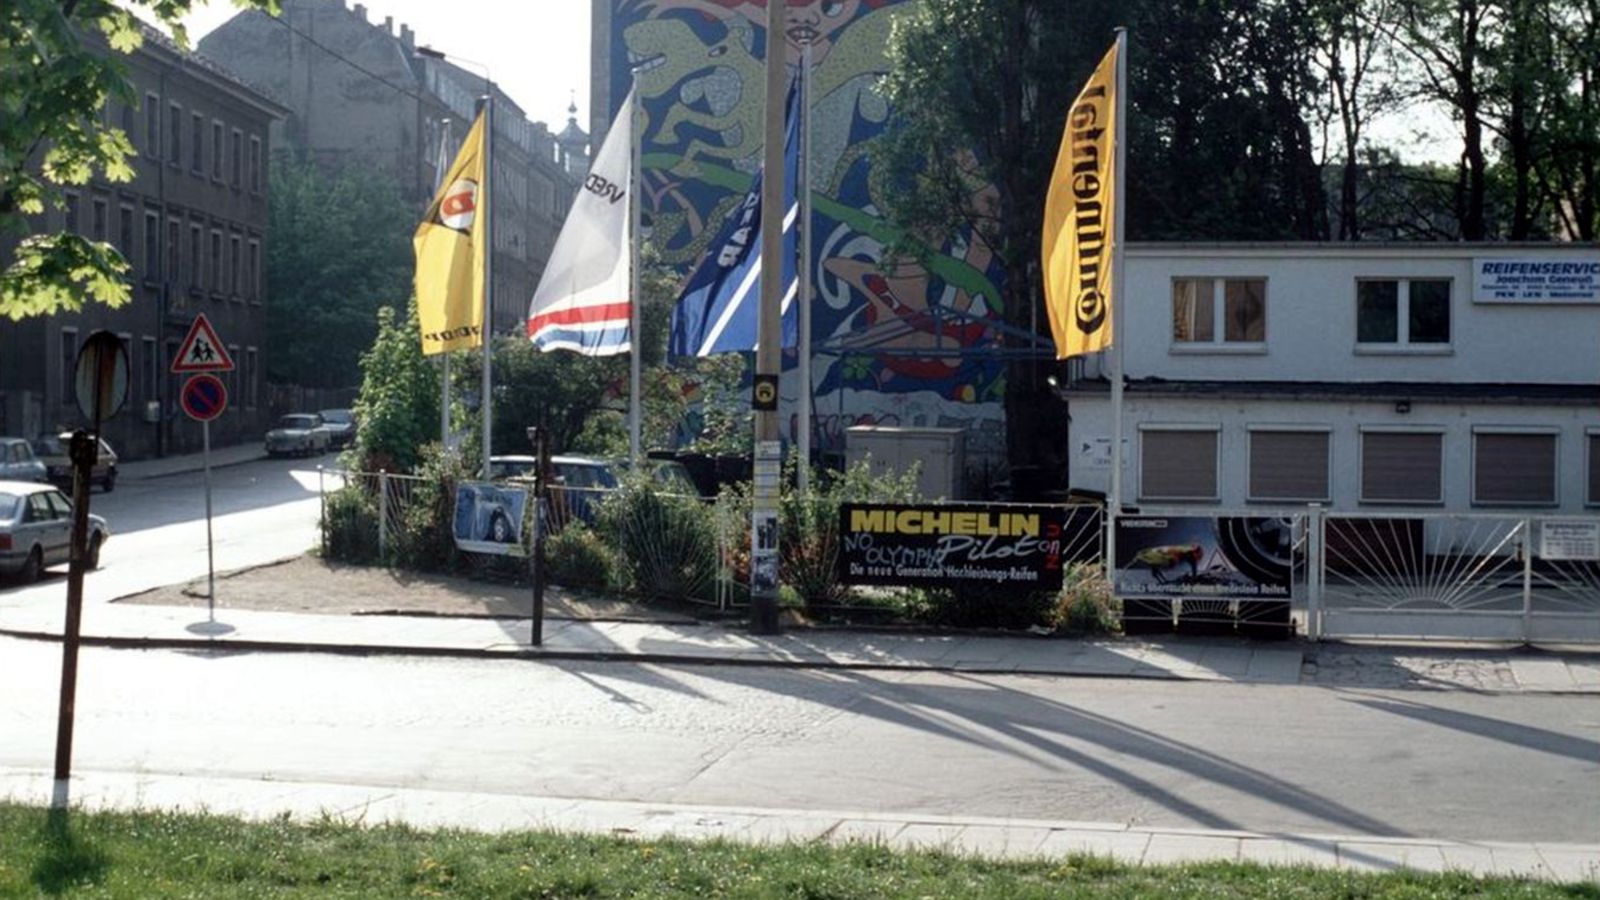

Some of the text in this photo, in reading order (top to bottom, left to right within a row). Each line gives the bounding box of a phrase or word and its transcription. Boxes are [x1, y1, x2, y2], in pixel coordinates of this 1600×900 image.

[851, 510, 1039, 536] MICHELIN
[937, 527, 1037, 565] Pilot
[850, 562, 864, 576] Die
[867, 566, 892, 576] neue
[896, 564, 944, 577] Generation
